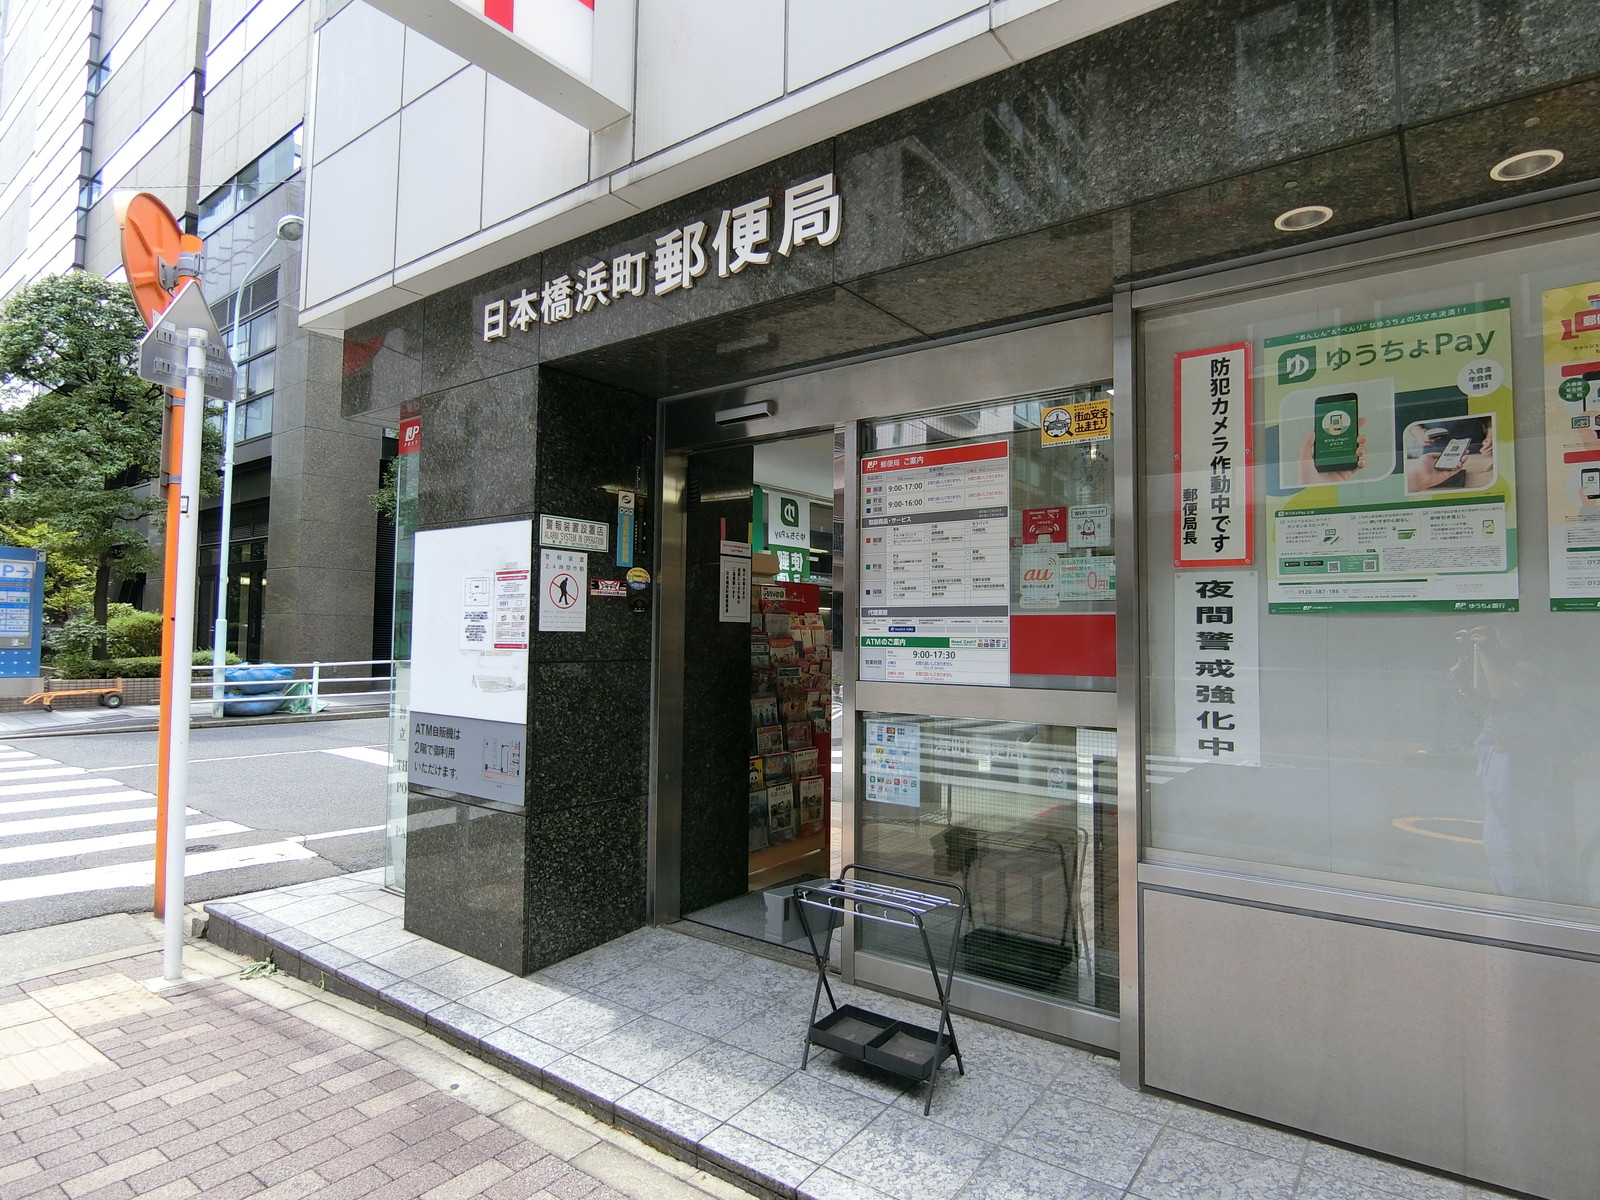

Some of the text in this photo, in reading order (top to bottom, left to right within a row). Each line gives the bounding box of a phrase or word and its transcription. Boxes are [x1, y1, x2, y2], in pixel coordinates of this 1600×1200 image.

[484, 172, 842, 342] 日本橋浜町郵便局
[1326, 330, 1495, 371] ゆうちょPay
[1468, 366, 1492, 375] 入会金
[1468, 374, 1492, 383] 年会費
[1472, 382, 1489, 391] 無料
[1074, 408, 1108, 422] 街の安全
[1074, 418, 1108, 433] みまもり
[903, 456, 924, 466] ご案内
[1210, 357, 1231, 553] 防犯カメラ作動中です
[888, 482, 923, 493] 9:00-17:00
[888, 498, 923, 509] 9:00-16:00
[1182, 488, 1198, 545] 郵便局長
[544, 530, 559, 540] ALARM
[560, 532, 577, 542] SYSTEM
[578, 535, 583, 543] IN
[584, 535, 604, 546] OPERATION
[3, 565, 14, 577] P
[1023, 568, 1054, 582] au
[866, 637, 906, 647] ATMのご案内
[912, 650, 956, 660] 9:00-17:30
[1195, 580, 1236, 756] 夜間警戒強化中
[414, 721, 461, 740] ATM自販機は
[414, 741, 456, 760] 2階で御利用
[414, 763, 459, 781] いただけます。
